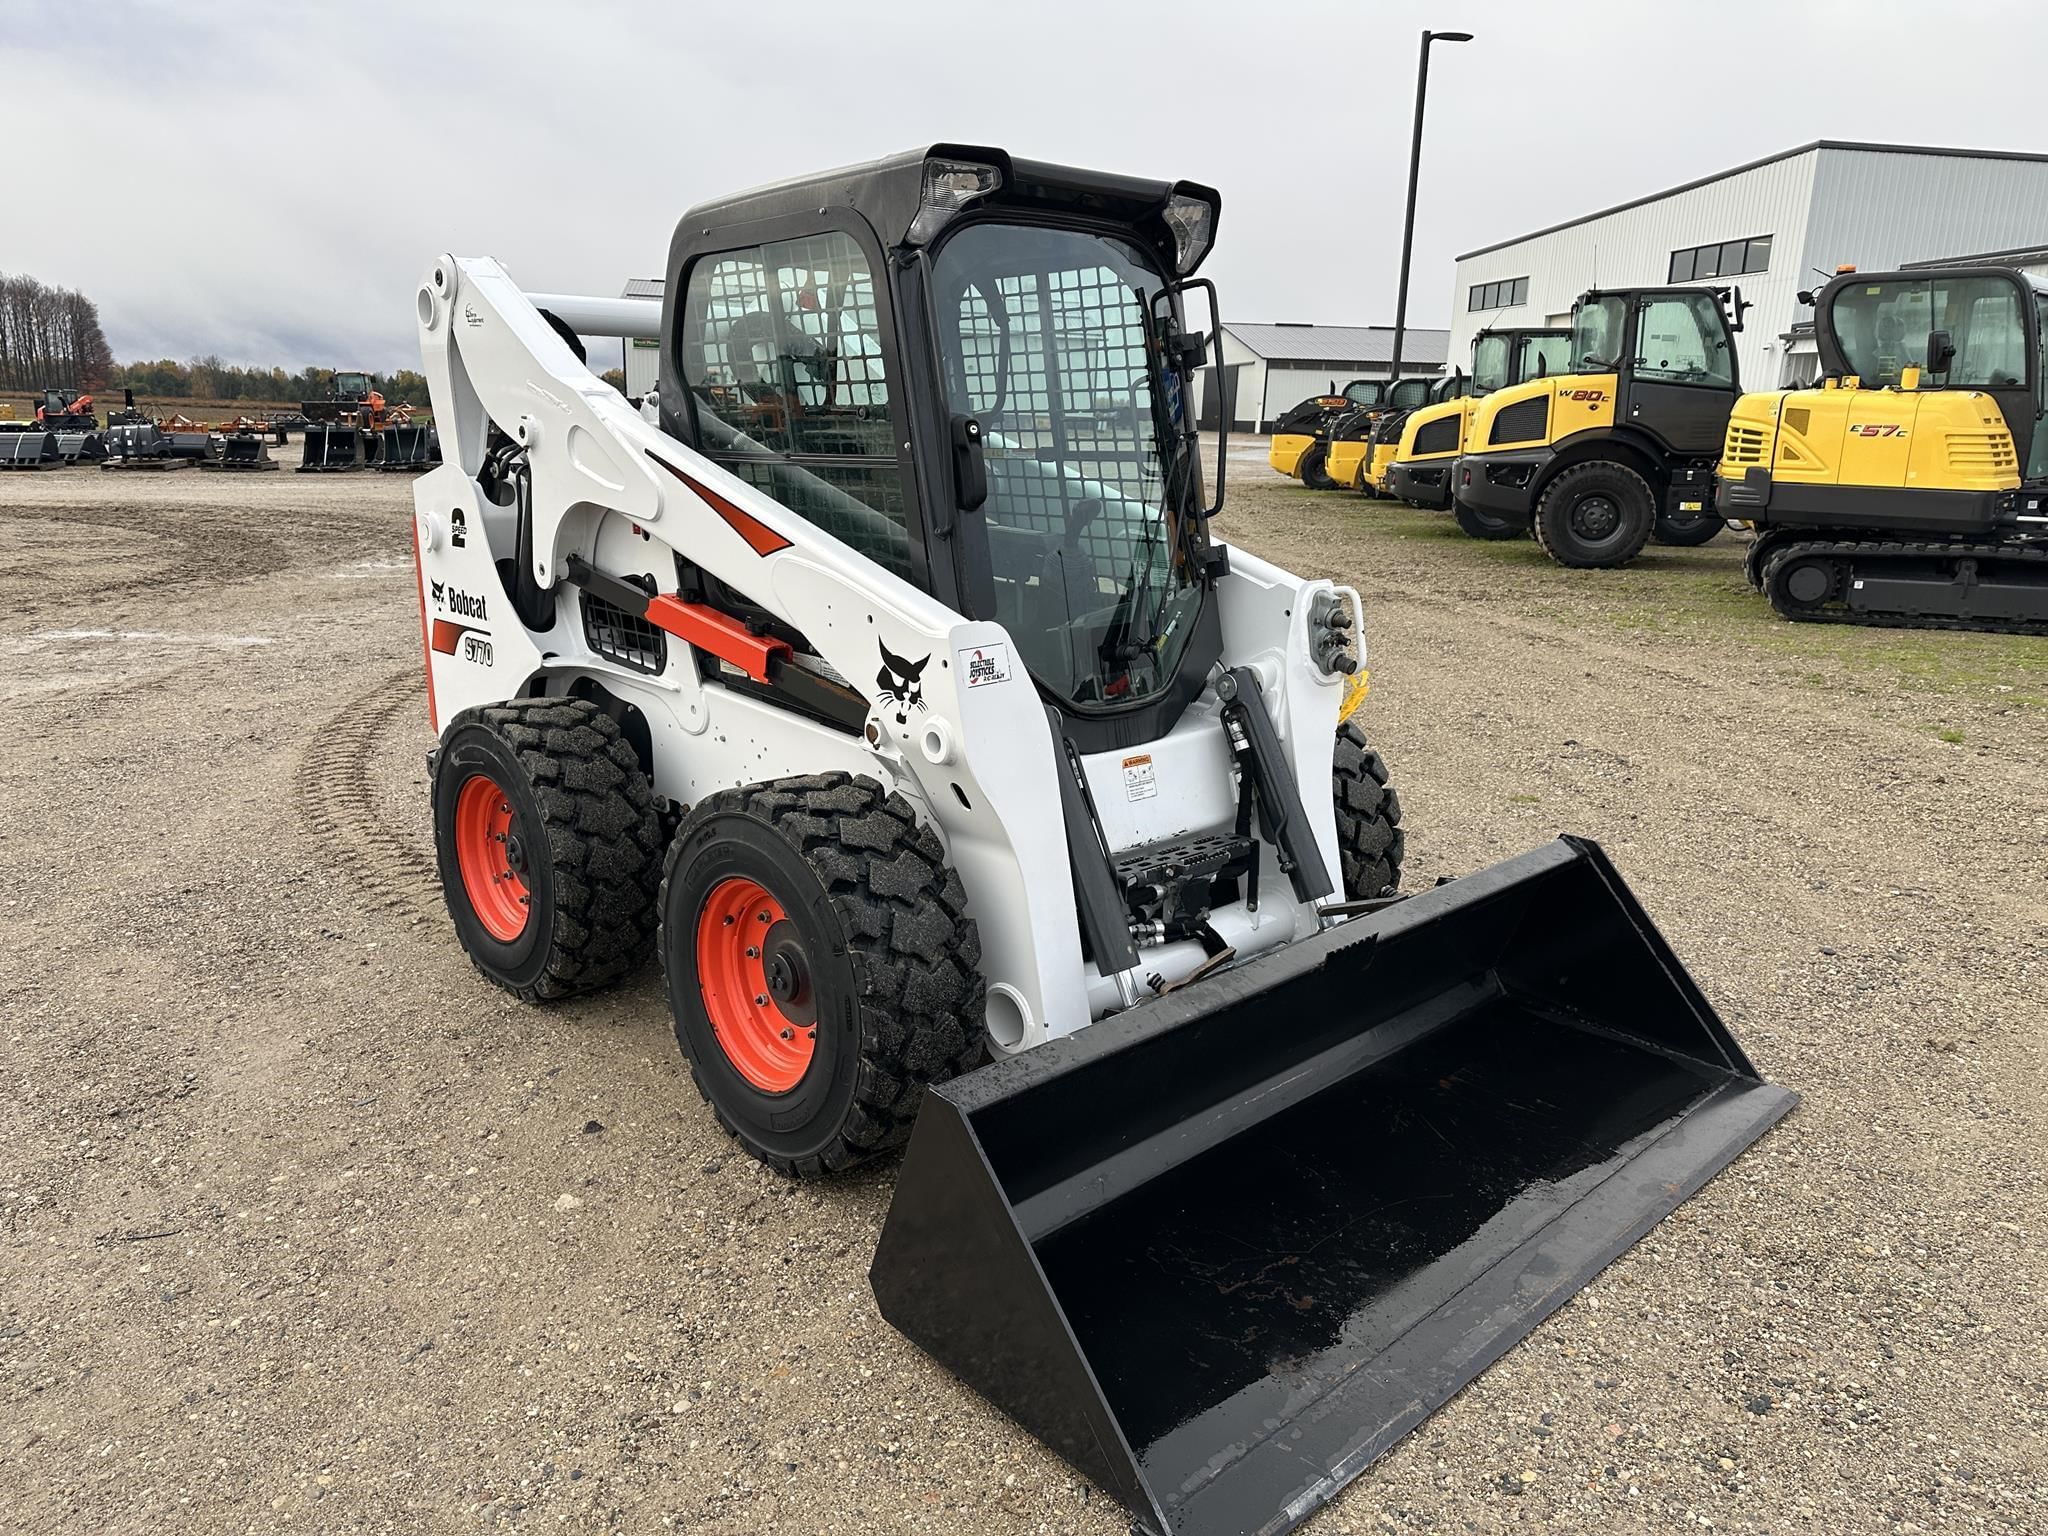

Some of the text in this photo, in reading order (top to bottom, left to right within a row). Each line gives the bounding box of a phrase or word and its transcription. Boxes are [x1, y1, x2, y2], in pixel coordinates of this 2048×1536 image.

[451, 525, 467, 535] SPEED
[448, 586, 487, 621] Bobcat
[464, 636, 494, 667] S770
[969, 665, 995, 679] JOYSTICKS
